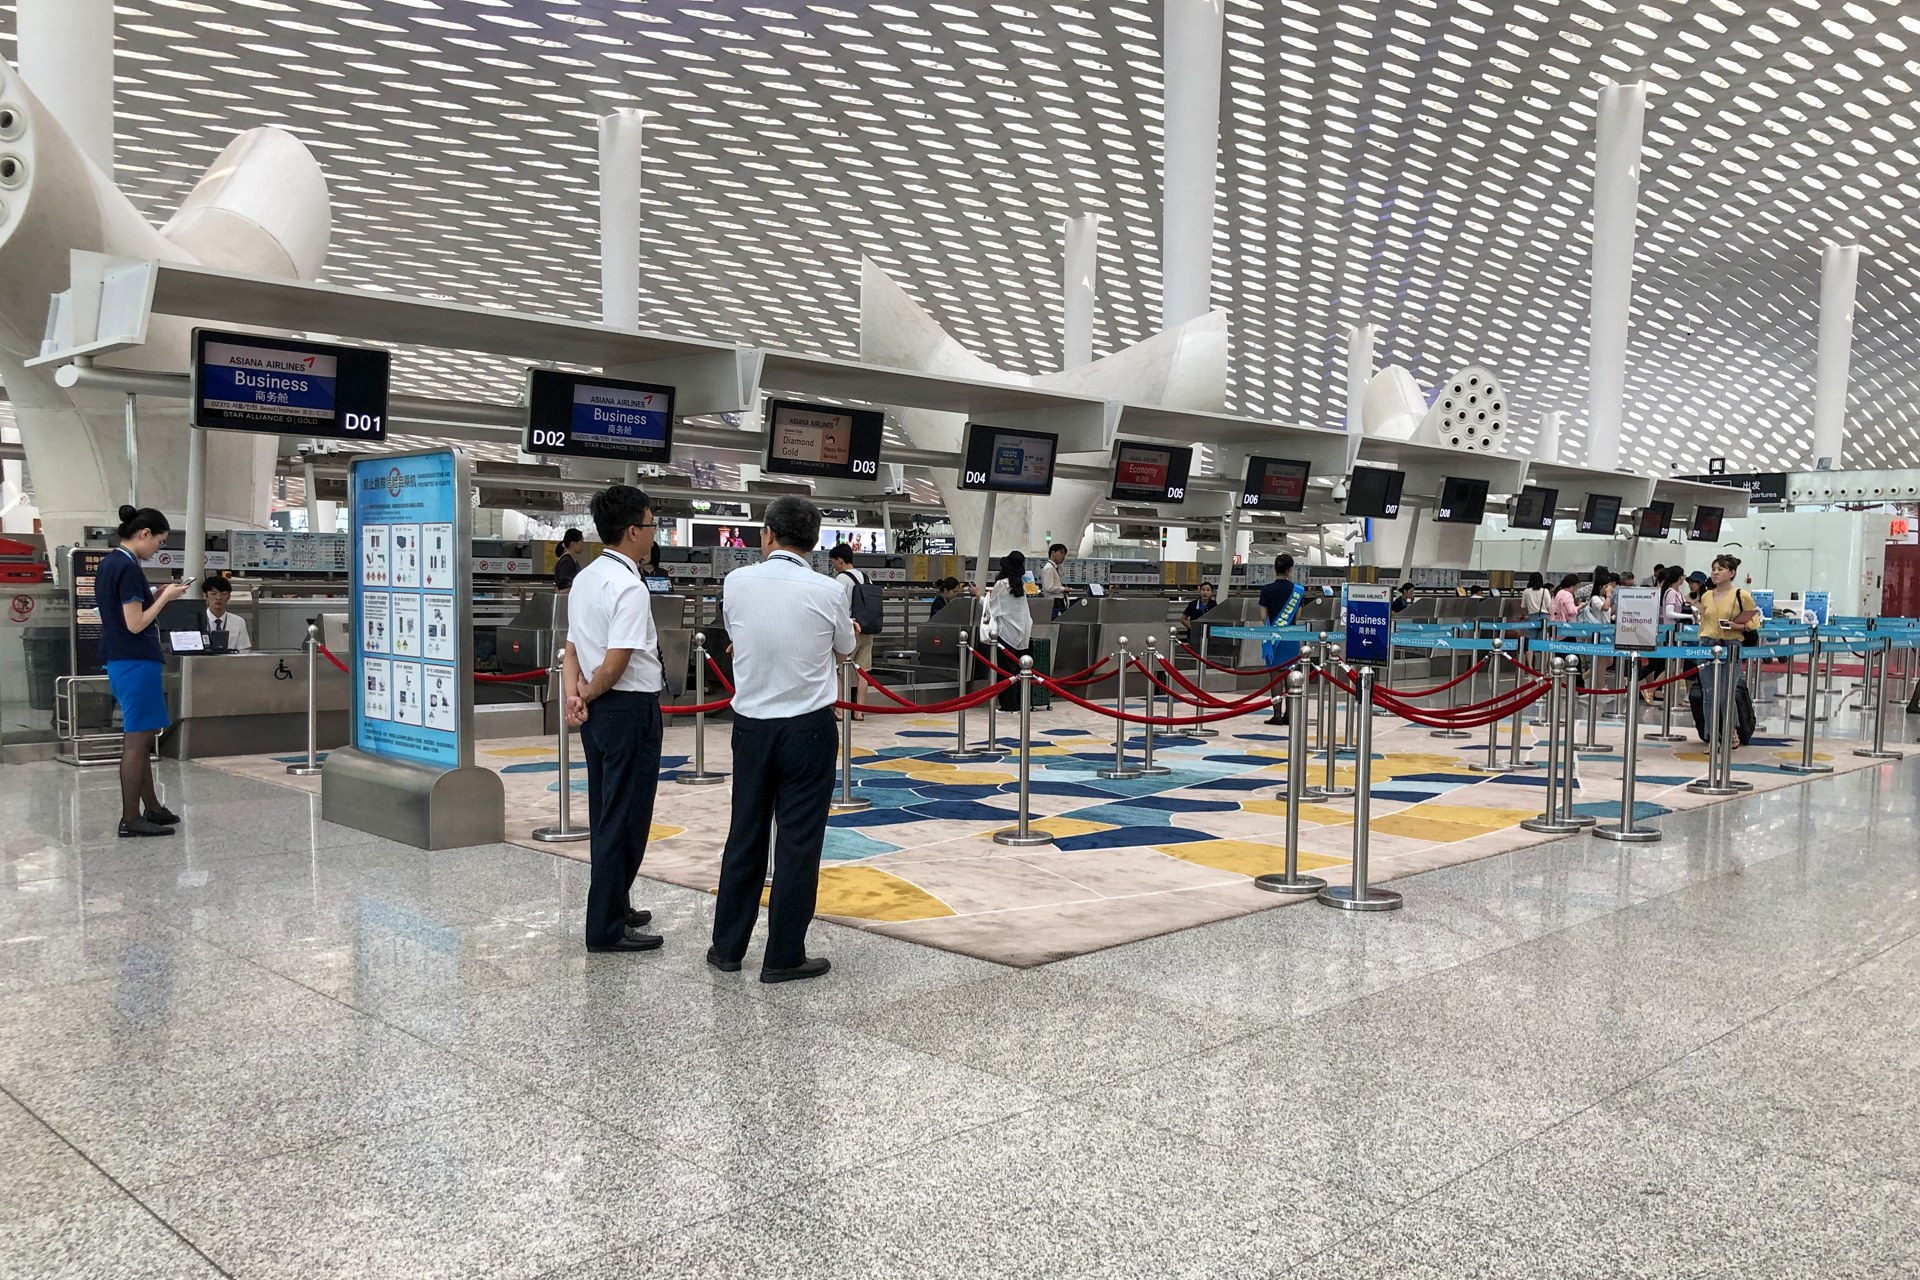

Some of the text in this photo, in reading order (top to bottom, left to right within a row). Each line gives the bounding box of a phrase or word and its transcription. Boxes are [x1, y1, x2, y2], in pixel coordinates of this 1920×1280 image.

[229, 356, 306, 372] ASIANA AIRLINES
[234, 370, 309, 392] Business
[254, 389, 289, 404] 商务舱
[590, 395, 646, 408] ASIANA AIRLINES
[223, 410, 319, 425] STAR ALLIANCE GOLD
[344, 412, 381, 432] D01
[593, 407, 647, 426] Business
[789, 418, 834, 429] ASIANA AIRLINES
[532, 429, 566, 447] D02
[783, 435, 815, 447] Diamond
[583, 441, 600, 449] STAR
[600, 443, 628, 452] ALLIANCE
[782, 447, 799, 457] Gold
[853, 459, 876, 474] D03
[1129, 463, 1159, 477] Economy
[966, 471, 987, 484] D04
[1743, 480, 1761, 491] 出发
[1167, 487, 1184, 499] D05
[1243, 493, 1259, 505] D06
[1750, 491, 1777, 499] partures
[1385, 504, 1398, 514] D07
[1439, 508, 1451, 518] D08
[1349, 613, 1387, 626] Business
[1621, 616, 1653, 624] Diamond
[1620, 625, 1637, 633] Gold
[1548, 643, 1587, 652] SHENZHEN
